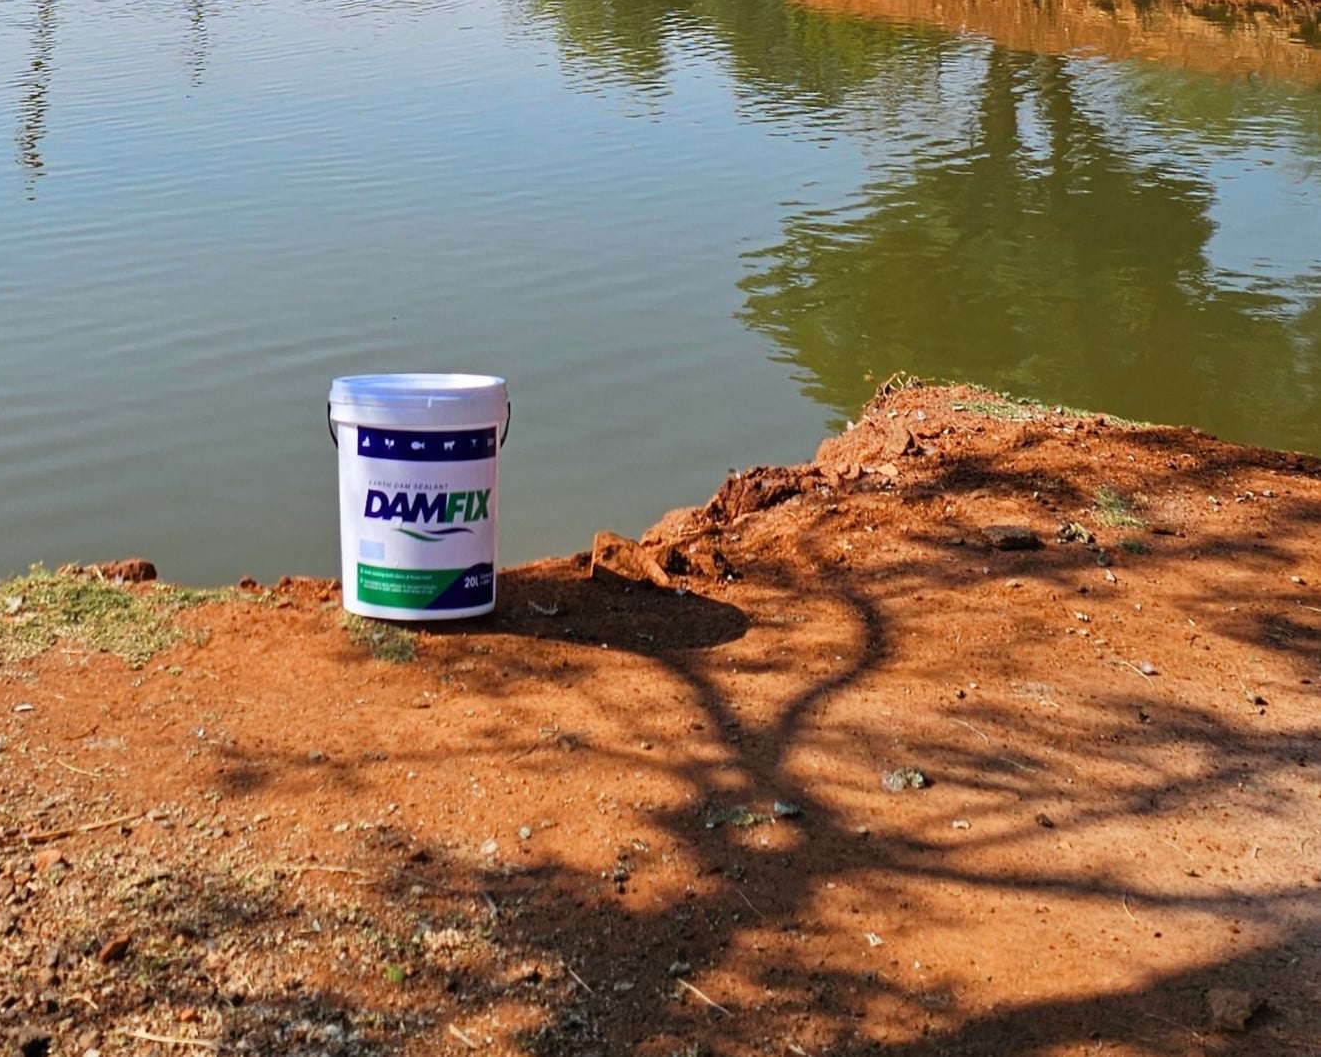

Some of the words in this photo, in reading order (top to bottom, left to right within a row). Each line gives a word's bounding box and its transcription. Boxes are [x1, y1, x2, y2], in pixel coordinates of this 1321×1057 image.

[394, 482, 411, 490] DAM
[413, 482, 449, 491] SEALANT
[364, 488, 492, 523] DAMFIX
